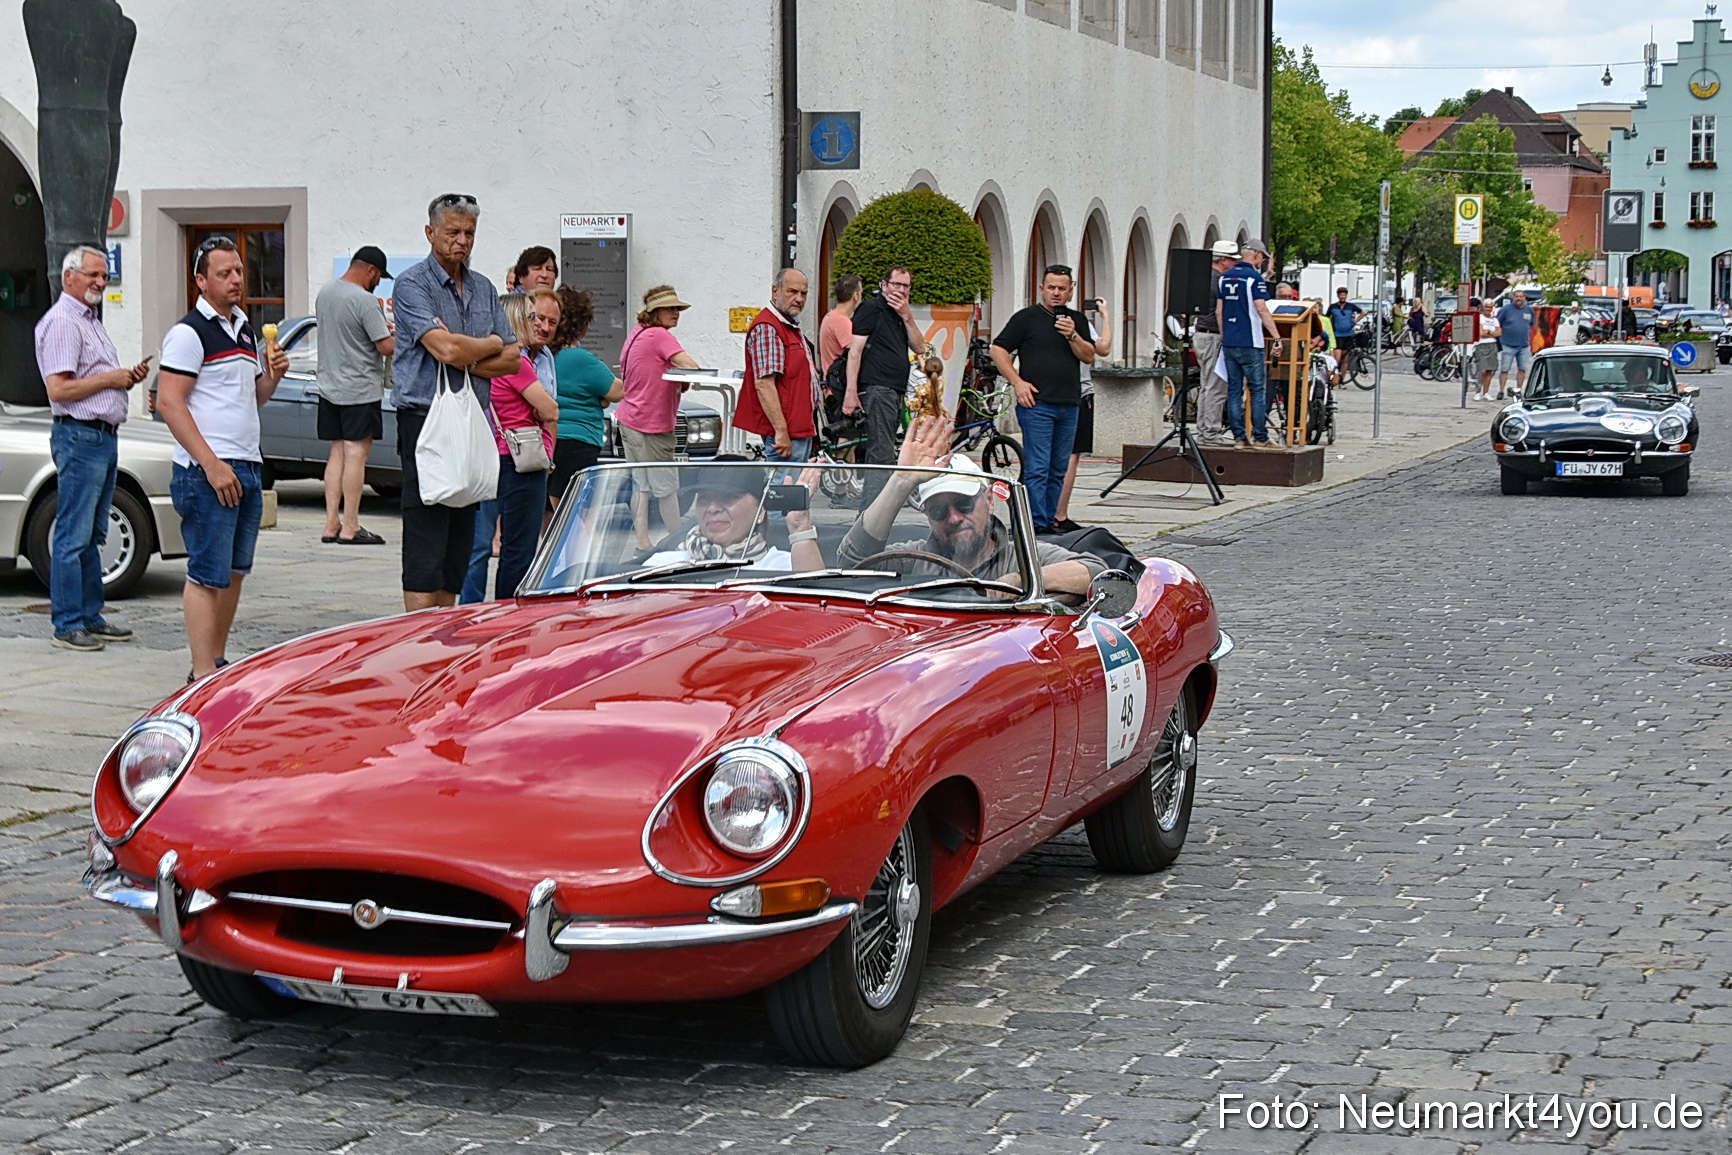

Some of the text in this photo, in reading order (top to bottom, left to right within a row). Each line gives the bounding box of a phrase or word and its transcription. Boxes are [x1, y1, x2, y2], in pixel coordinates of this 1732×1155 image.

[563, 217, 616, 226] NEUMARKT
[1563, 463, 1622, 474] FÜ JY 67H
[1120, 693, 1134, 729] 48
